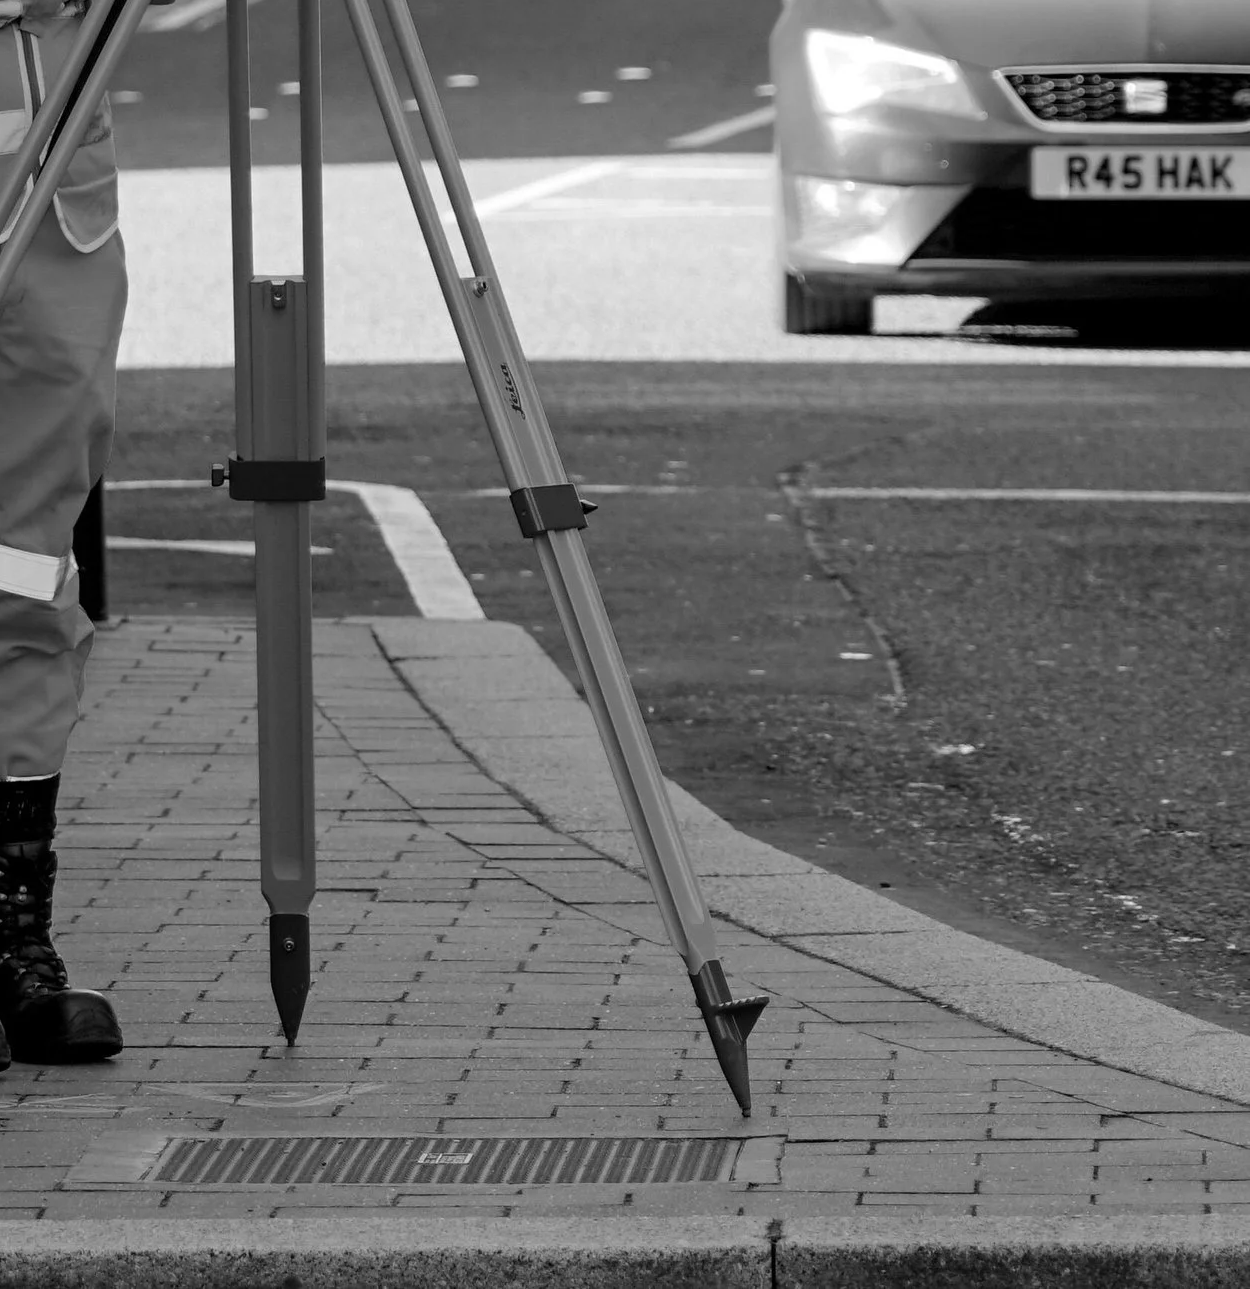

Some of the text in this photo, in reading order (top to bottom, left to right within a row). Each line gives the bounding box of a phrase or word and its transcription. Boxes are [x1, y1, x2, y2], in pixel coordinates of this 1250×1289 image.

[1067, 154, 1234, 190] R45 HAK
[500, 362, 526, 420] Leica
